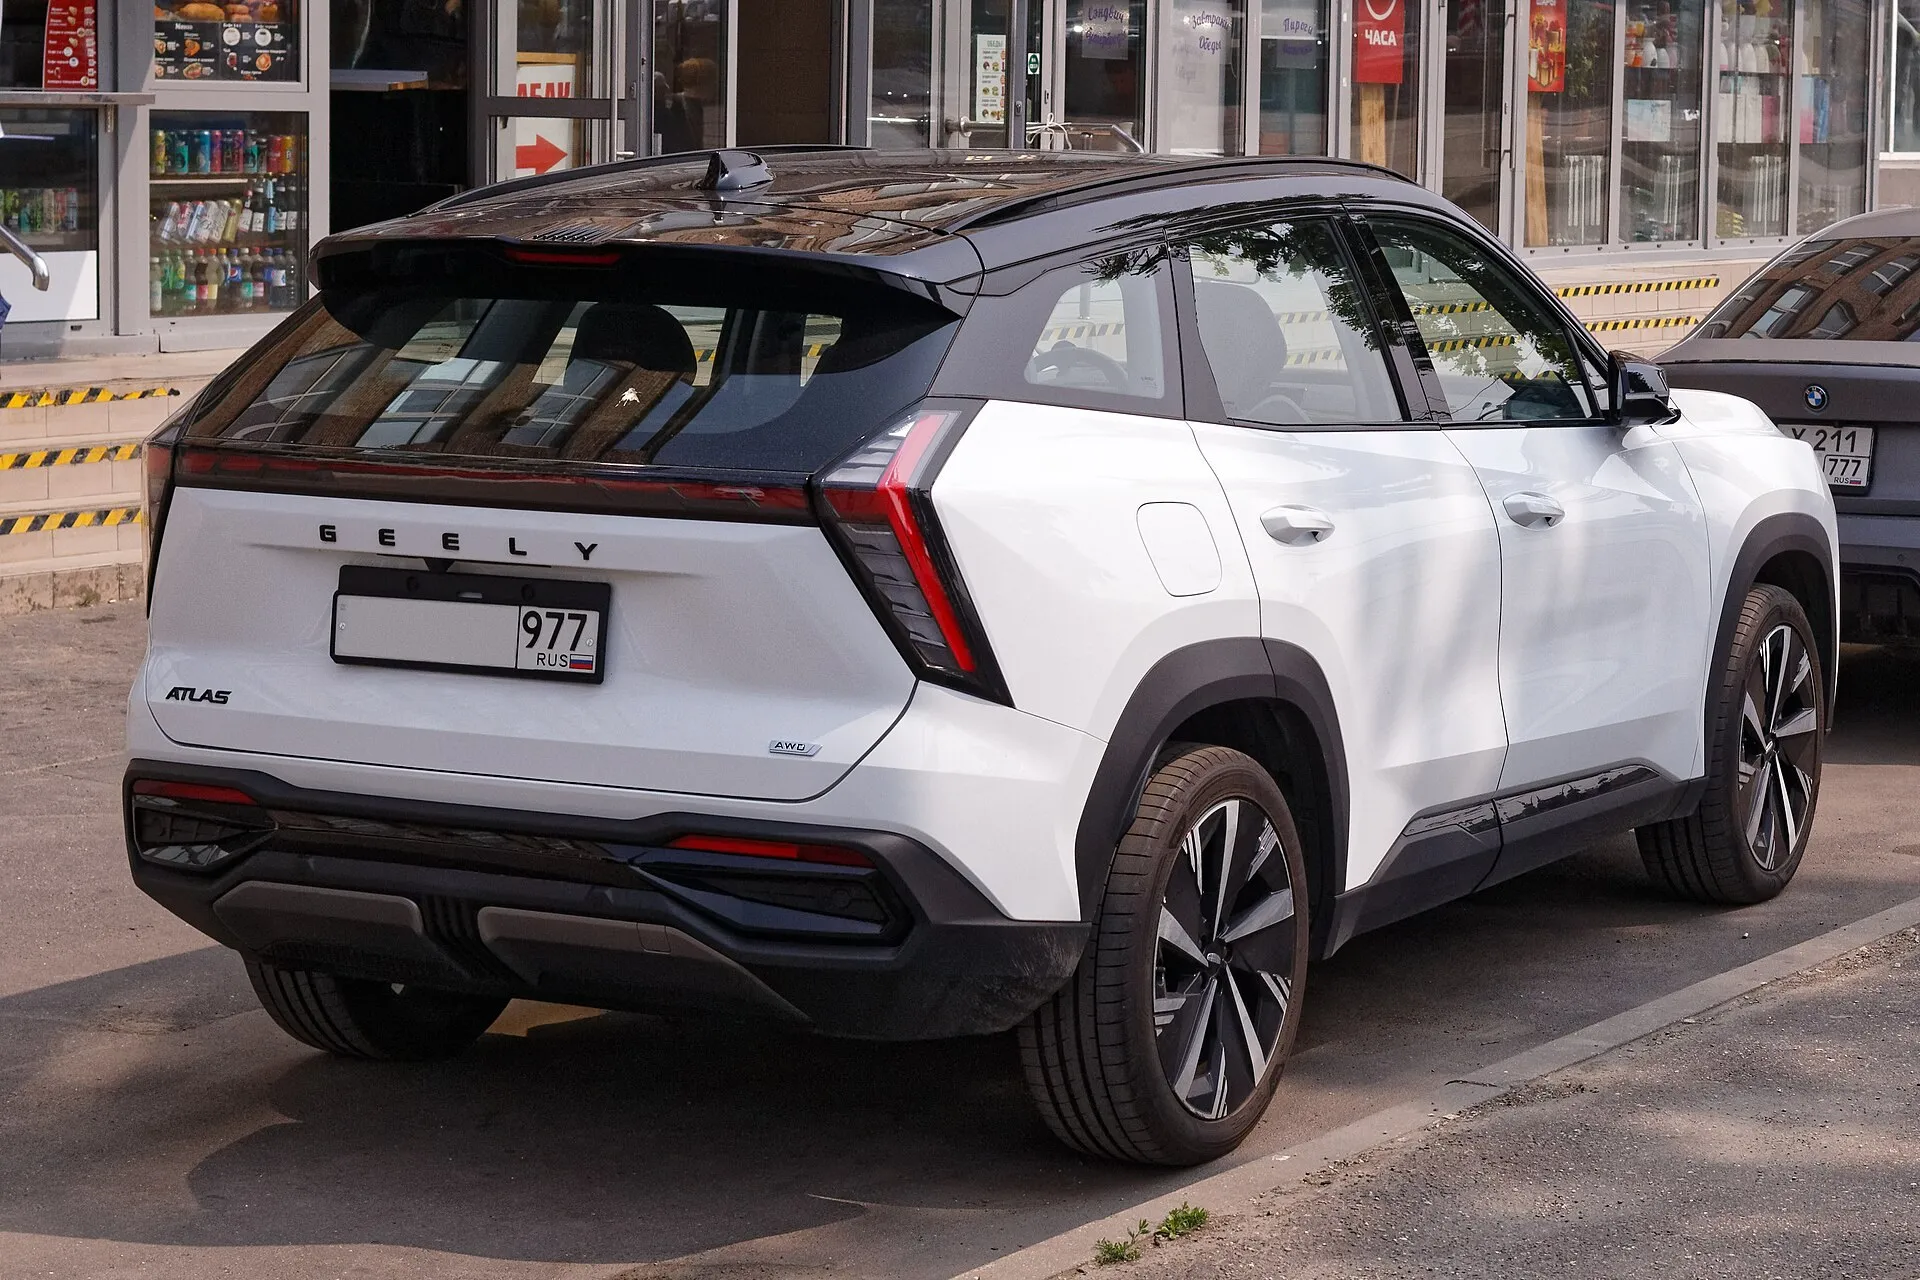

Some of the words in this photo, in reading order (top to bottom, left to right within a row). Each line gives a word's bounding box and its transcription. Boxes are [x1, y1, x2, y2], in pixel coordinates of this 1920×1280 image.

[1364, 29, 1397, 46] ЧАСА
[1813, 429, 1857, 453] 211
[1829, 458, 1862, 477] 777
[1833, 476, 1850, 485] RUS
[319, 524, 598, 561] GEELY
[522, 610, 588, 652] 977
[536, 652, 569, 668] RUS
[165, 686, 232, 705] ATLAS
[774, 741, 806, 751] AWD
